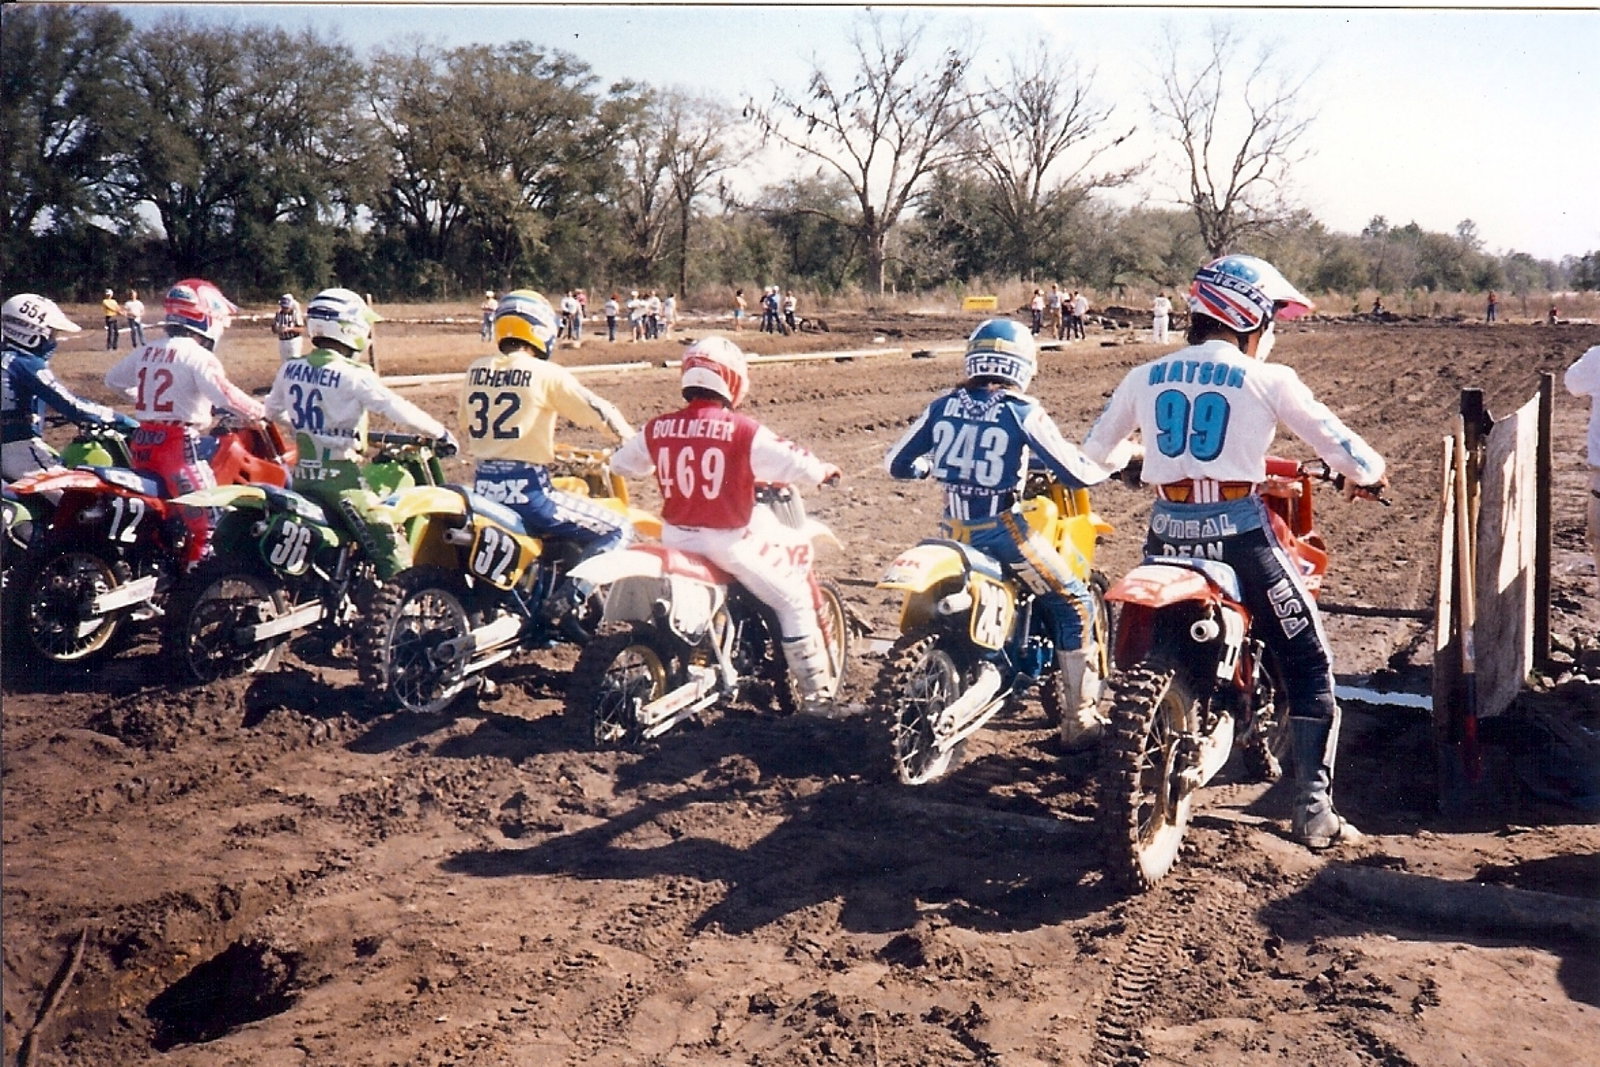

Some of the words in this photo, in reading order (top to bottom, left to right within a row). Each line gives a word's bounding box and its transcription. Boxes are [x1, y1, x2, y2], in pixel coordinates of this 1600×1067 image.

[19, 300, 47, 324] 554
[135, 367, 174, 412] 12
[284, 363, 341, 389] MANNEH
[468, 367, 532, 388] TICHENOR
[1148, 360, 1246, 389] MATSON
[289, 384, 325, 431] 36
[468, 391, 522, 439] 32
[652, 418, 735, 442] BOLLMEIER
[1155, 389, 1230, 461] 99
[657, 446, 726, 499] 469
[931, 421, 1009, 488] 243
[108, 497, 145, 542] 12
[270, 520, 311, 572] 36
[474, 527, 515, 584] 32
[1162, 541, 1223, 561] DEAN
[1267, 578, 1309, 640] USA
